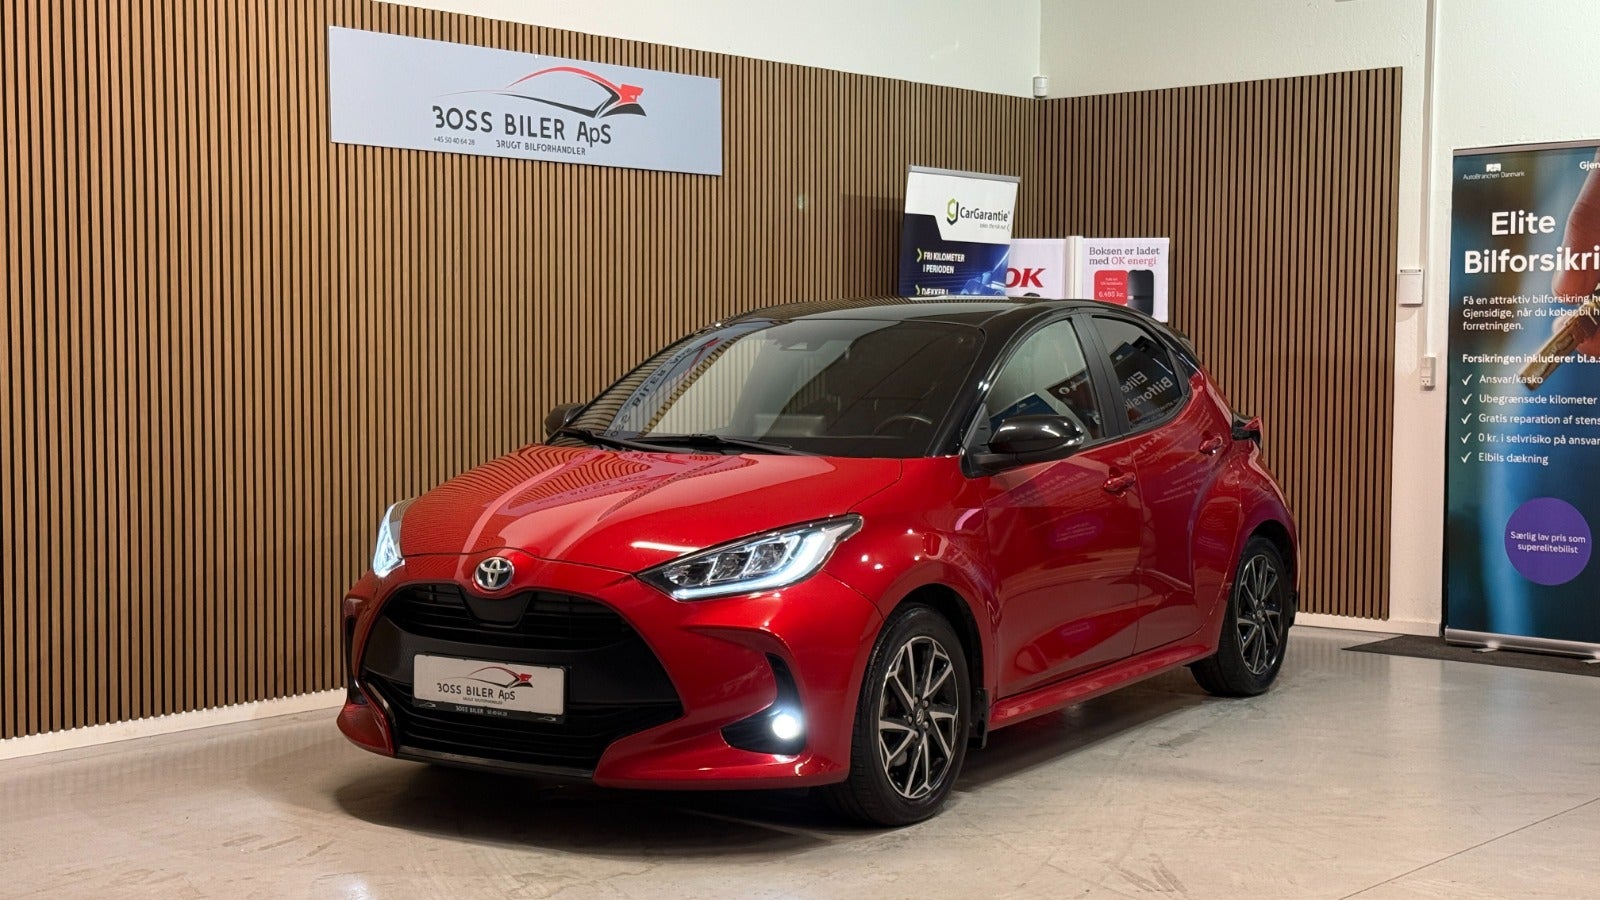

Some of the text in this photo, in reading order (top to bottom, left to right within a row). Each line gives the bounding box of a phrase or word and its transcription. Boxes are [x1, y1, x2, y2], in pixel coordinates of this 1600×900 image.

[504, 113, 565, 140] BILER
[576, 121, 612, 148] ApS
[453, 137, 460, 145] 40
[524, 142, 586, 155] BILFORHANDLER
[1491, 210, 1556, 235] Elite
[923, 251, 965, 262] FRI KILOMETER
[1089, 246, 1122, 255] Boksen
[1136, 246, 1160, 255] ladet
[1089, 256, 1157, 267] med OK energi
[1464, 245, 1600, 274] Bilforsikri
[926, 264, 954, 274] PERIODEN
[1004, 267, 1046, 288] OK
[1463, 295, 1474, 305] Få
[1476, 297, 1487, 305] en
[1489, 295, 1530, 304] attraktiv
[1532, 293, 1590, 305] bilforsikring
[1463, 308, 1514, 319] Gjensidige,
[1516, 307, 1532, 317] når
[1534, 308, 1546, 317] du
[1548, 308, 1577, 317] køber
[1579, 307, 1590, 316] bil
[1463, 321, 1524, 332] forretningen.
[1462, 353, 1522, 365] Forsikringen
[1523, 353, 1575, 363] inkluderer
[1479, 374, 1544, 384] Ansvar/kasko
[1479, 393, 1598, 405] Ubegrænsede kilometer
[1478, 413, 1508, 423] Gratis
[1509, 414, 1560, 425] reparation
[1562, 415, 1573, 424] af
[1478, 432, 1485, 442] 0
[1487, 433, 1499, 443] kr.
[1506, 434, 1551, 444] selvrisiko
[1553, 435, 1566, 446] på
[1478, 452, 1549, 466] Elbils dækning
[1510, 531, 1586, 544] Særlig lav pris som
[1517, 543, 1579, 554] superelitebilist
[466, 686, 494, 698] BILER
[498, 689, 516, 701] ApS
